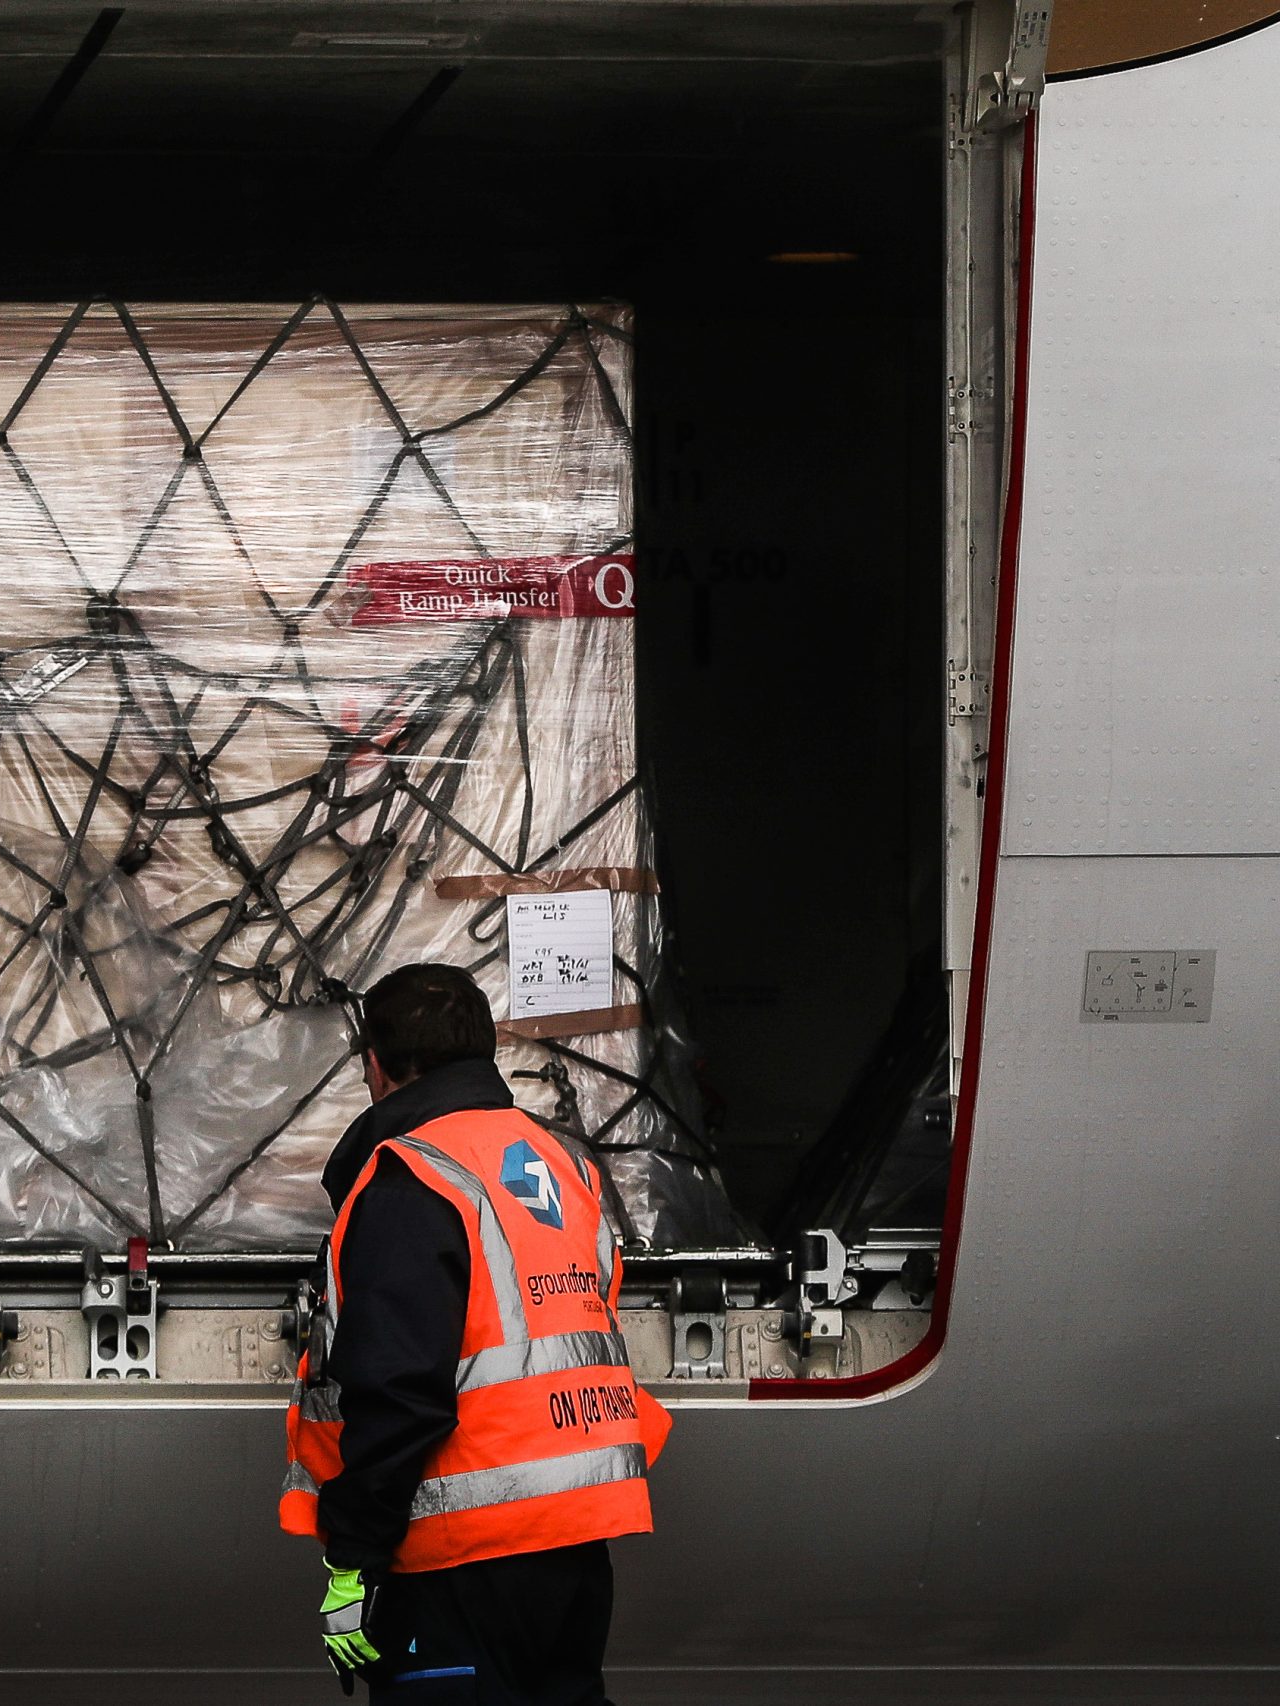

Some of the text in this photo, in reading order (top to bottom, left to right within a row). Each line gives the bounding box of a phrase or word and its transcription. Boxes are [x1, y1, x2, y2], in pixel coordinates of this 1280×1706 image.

[444, 565, 514, 586] Quick
[641, 547, 787, 582] TA 500
[399, 588, 559, 614] Ramp Transfer
[549, 1390, 577, 1430] ON
[577, 1386, 601, 1435] JOB
